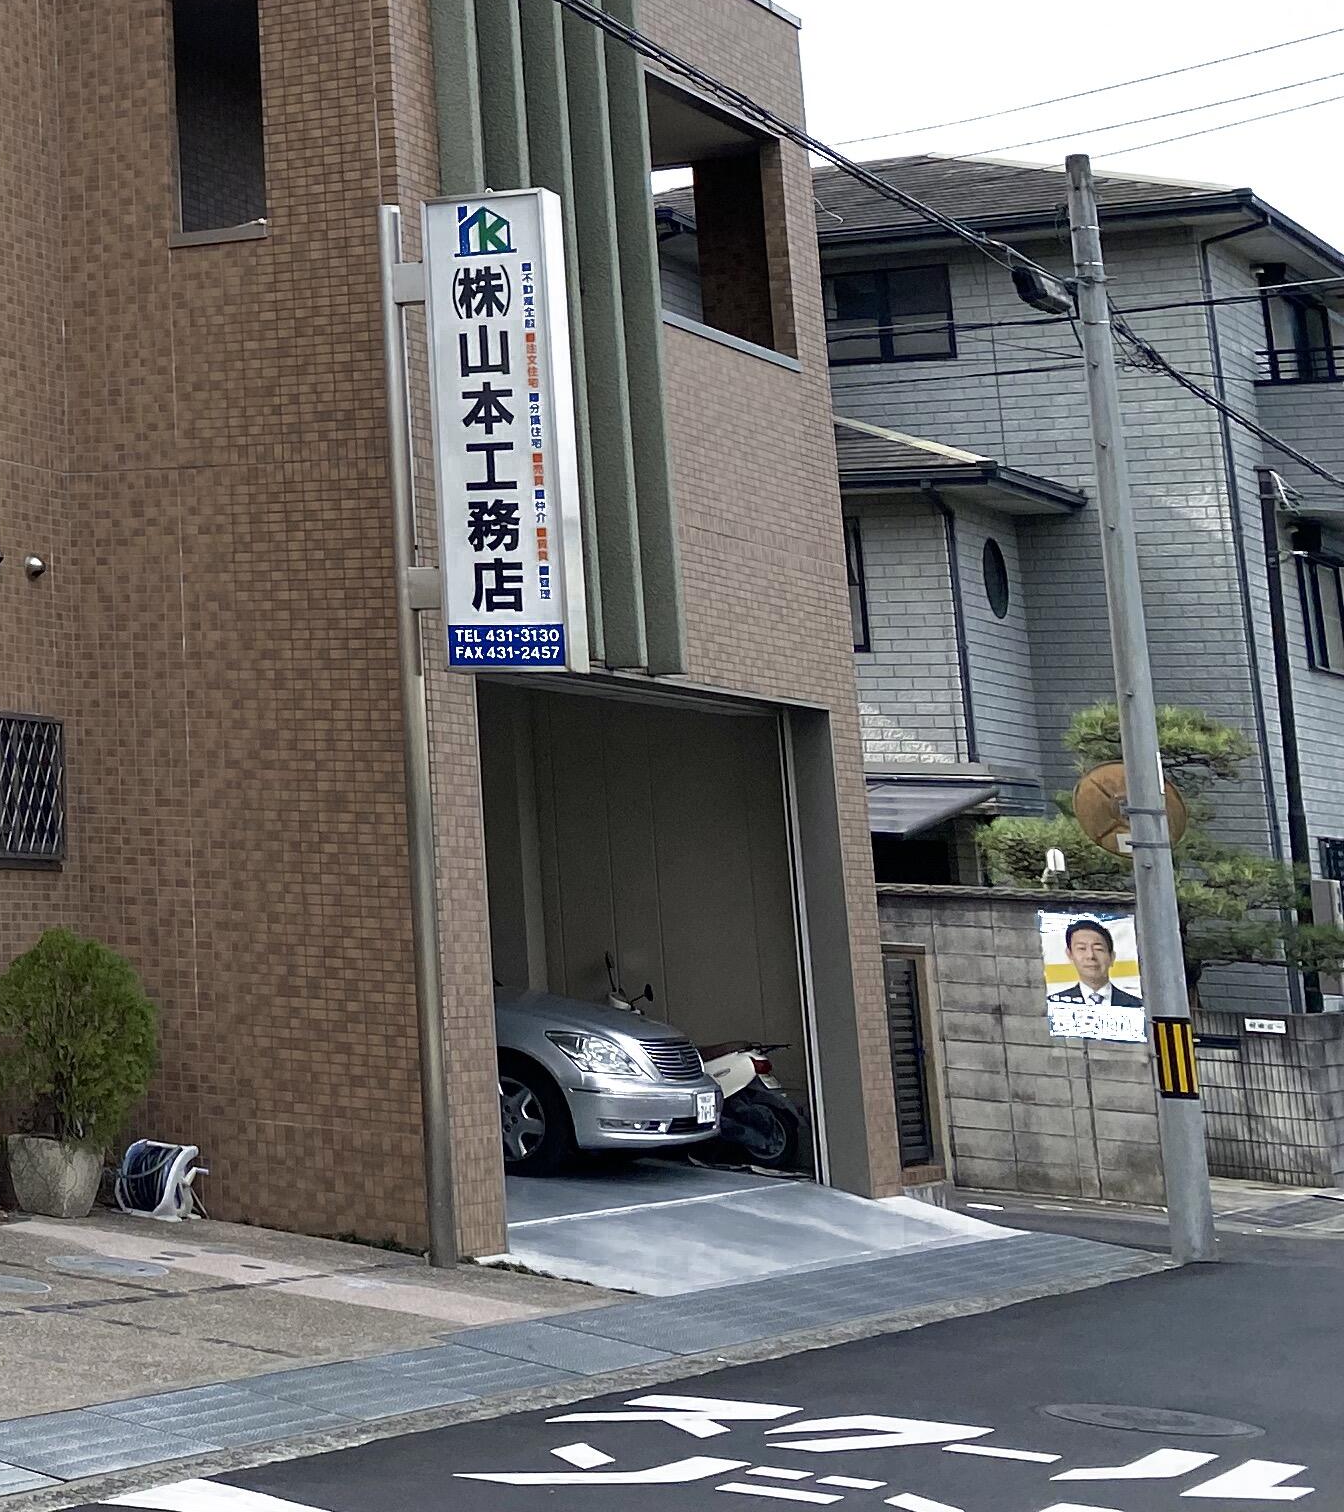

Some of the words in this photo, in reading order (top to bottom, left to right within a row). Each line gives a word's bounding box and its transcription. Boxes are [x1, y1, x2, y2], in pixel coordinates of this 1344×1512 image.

[453, 265, 523, 612] (株)山本工務店
[455, 629, 482, 642] TEL
[486, 629, 559, 642] 431-3130
[455, 646, 483, 659] FAX
[486, 646, 560, 659] 431-2457
[545, 1395, 1315, 1500] スクール
